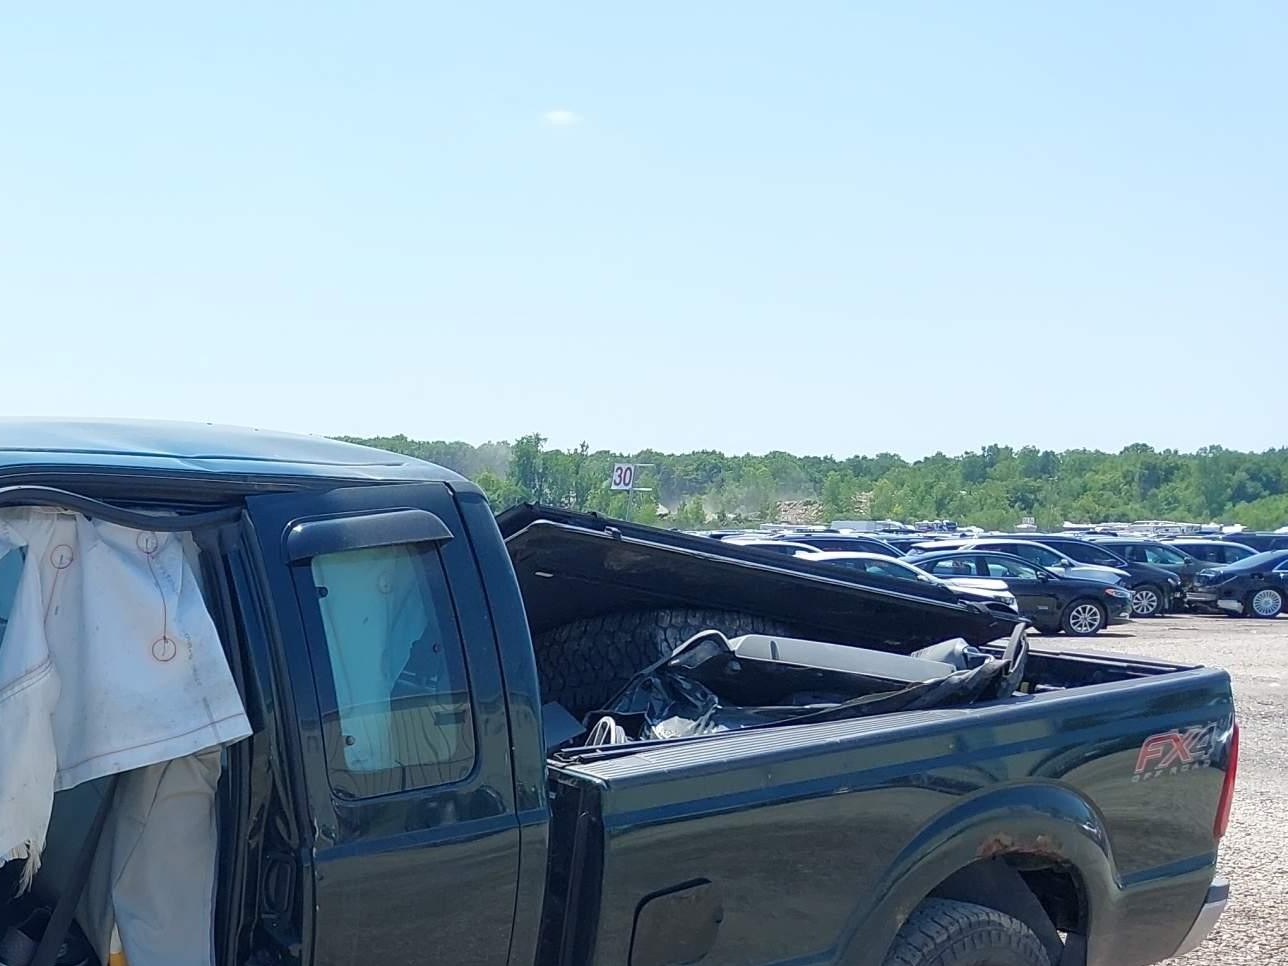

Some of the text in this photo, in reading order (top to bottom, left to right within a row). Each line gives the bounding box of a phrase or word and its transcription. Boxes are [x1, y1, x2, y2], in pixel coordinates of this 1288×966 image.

[613, 466, 633, 487] 30
[1135, 720, 1217, 773] FX4
[1168, 757, 1211, 776] ROAD
